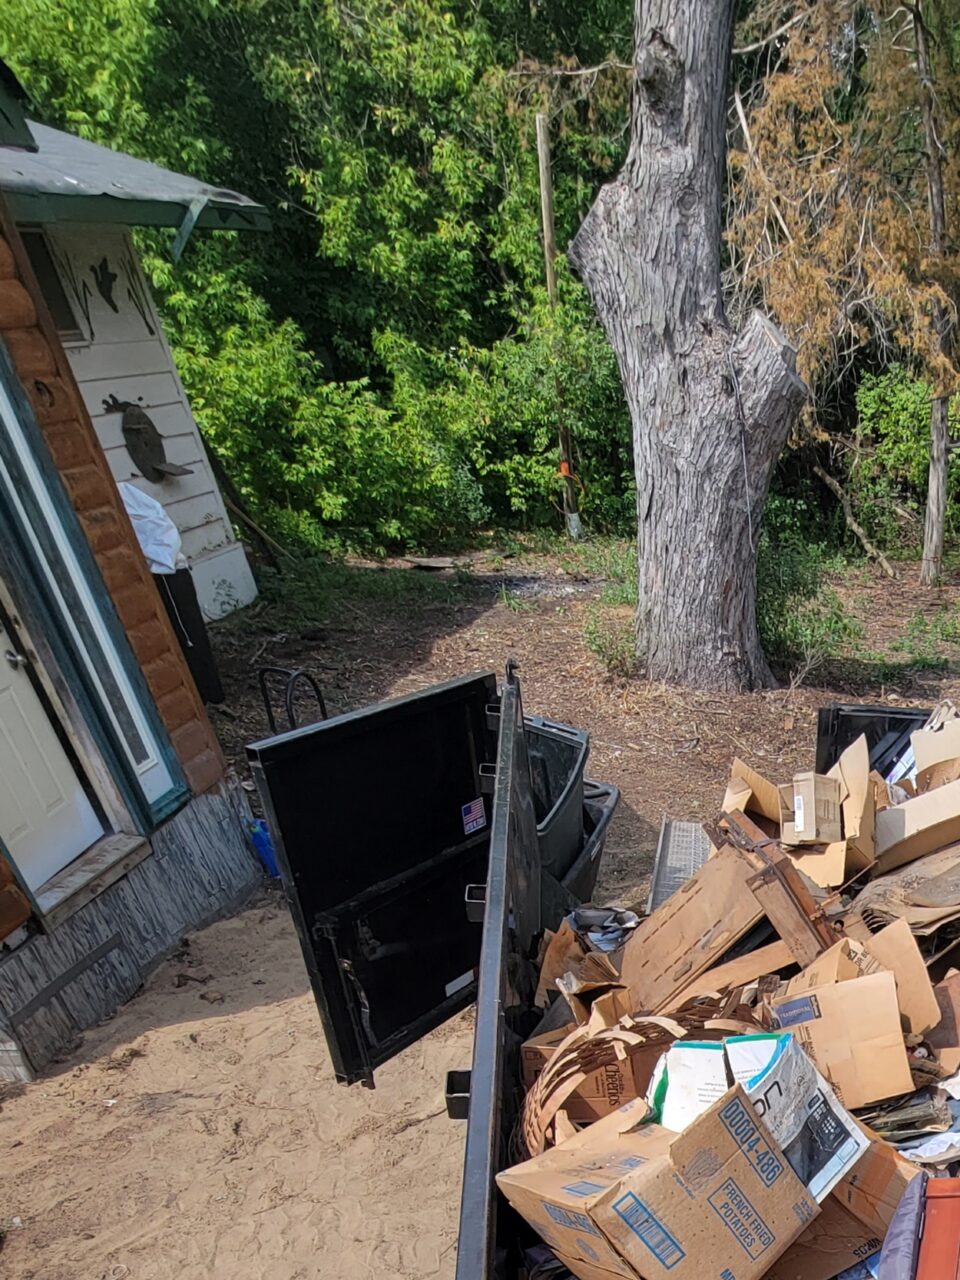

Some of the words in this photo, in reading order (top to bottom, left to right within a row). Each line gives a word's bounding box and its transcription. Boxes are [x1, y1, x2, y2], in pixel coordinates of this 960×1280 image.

[721, 1102, 784, 1184] 00004-486
[719, 1201, 757, 1249] POTATOES
[722, 1182, 755, 1222] FRENCH
[748, 1218, 773, 1247] FRIED
